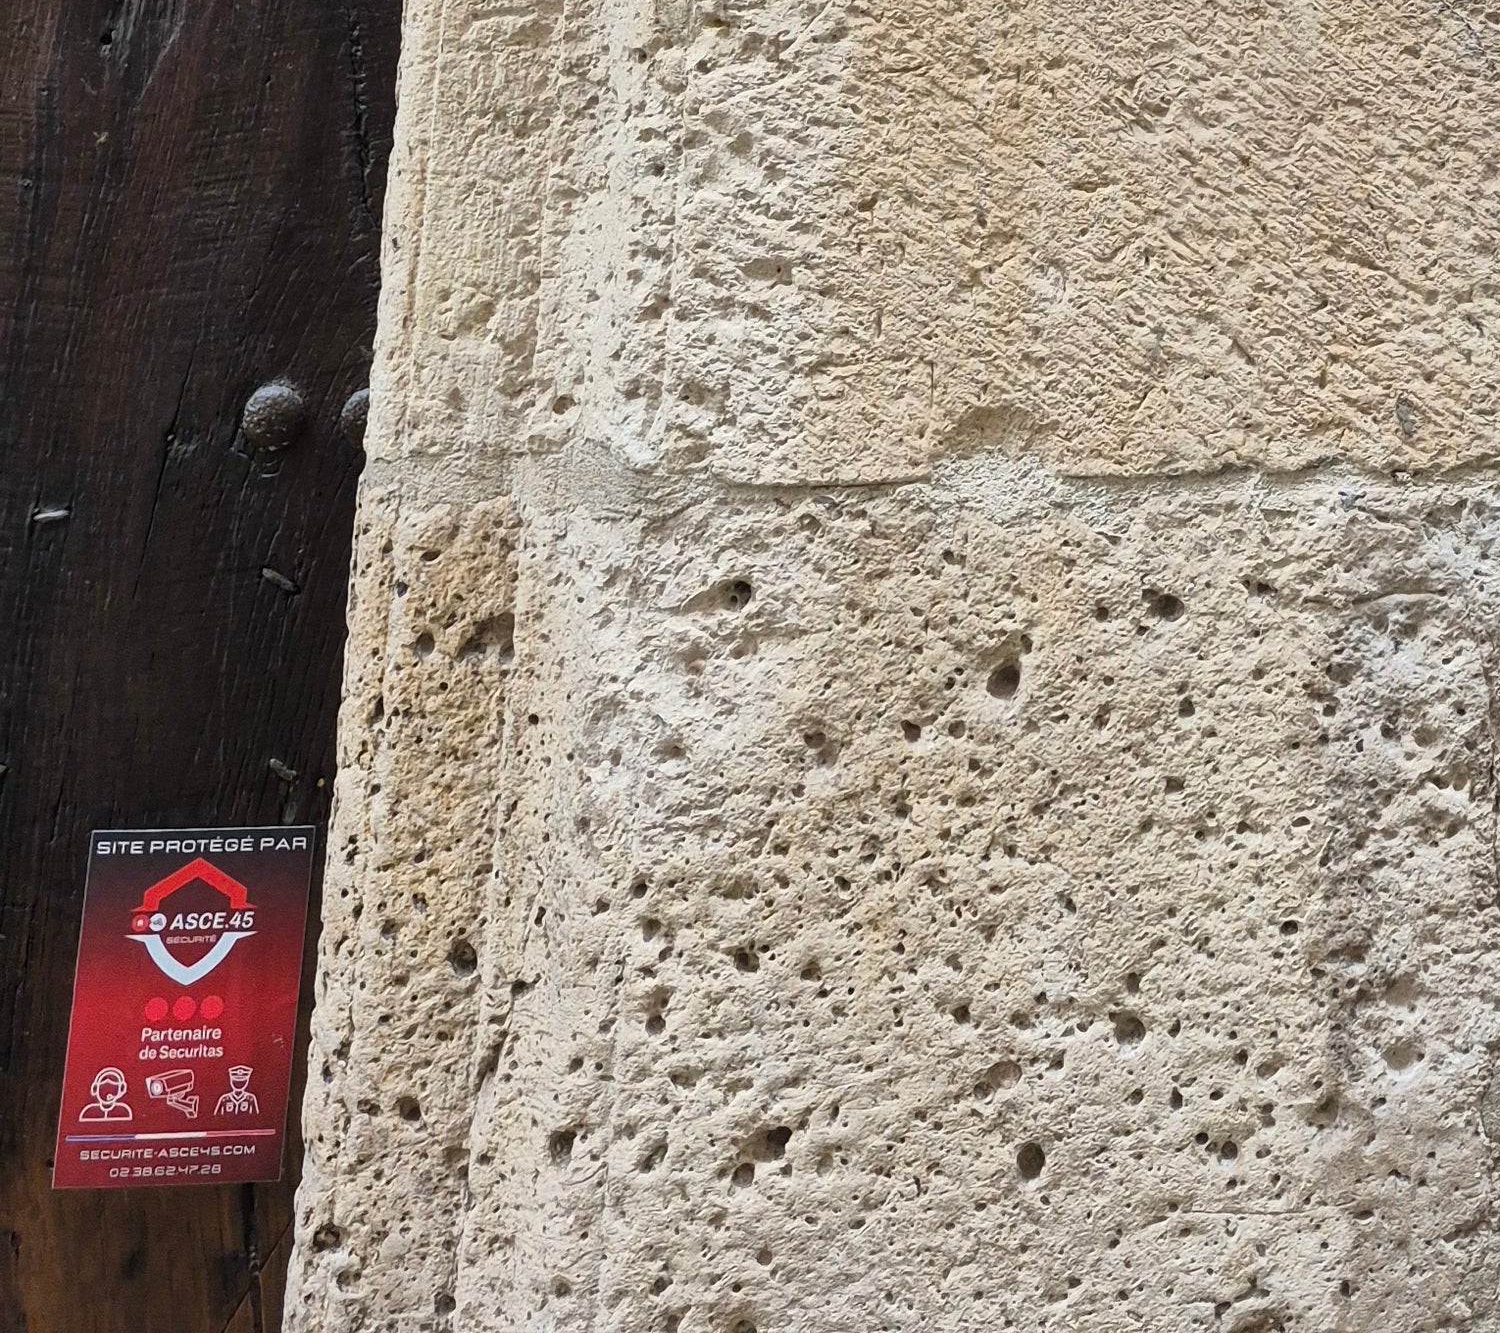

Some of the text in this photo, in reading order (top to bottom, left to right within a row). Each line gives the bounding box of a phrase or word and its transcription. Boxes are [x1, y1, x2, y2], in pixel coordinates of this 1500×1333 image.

[96, 836, 308, 855] SITE PROTÉGÉ PAR
[168, 911, 256, 931] ASCE.45
[141, 1025, 222, 1042] Partenaire
[139, 1044, 224, 1060] de Securitas
[109, 1164, 222, 1178] 02.38.62.47.28
